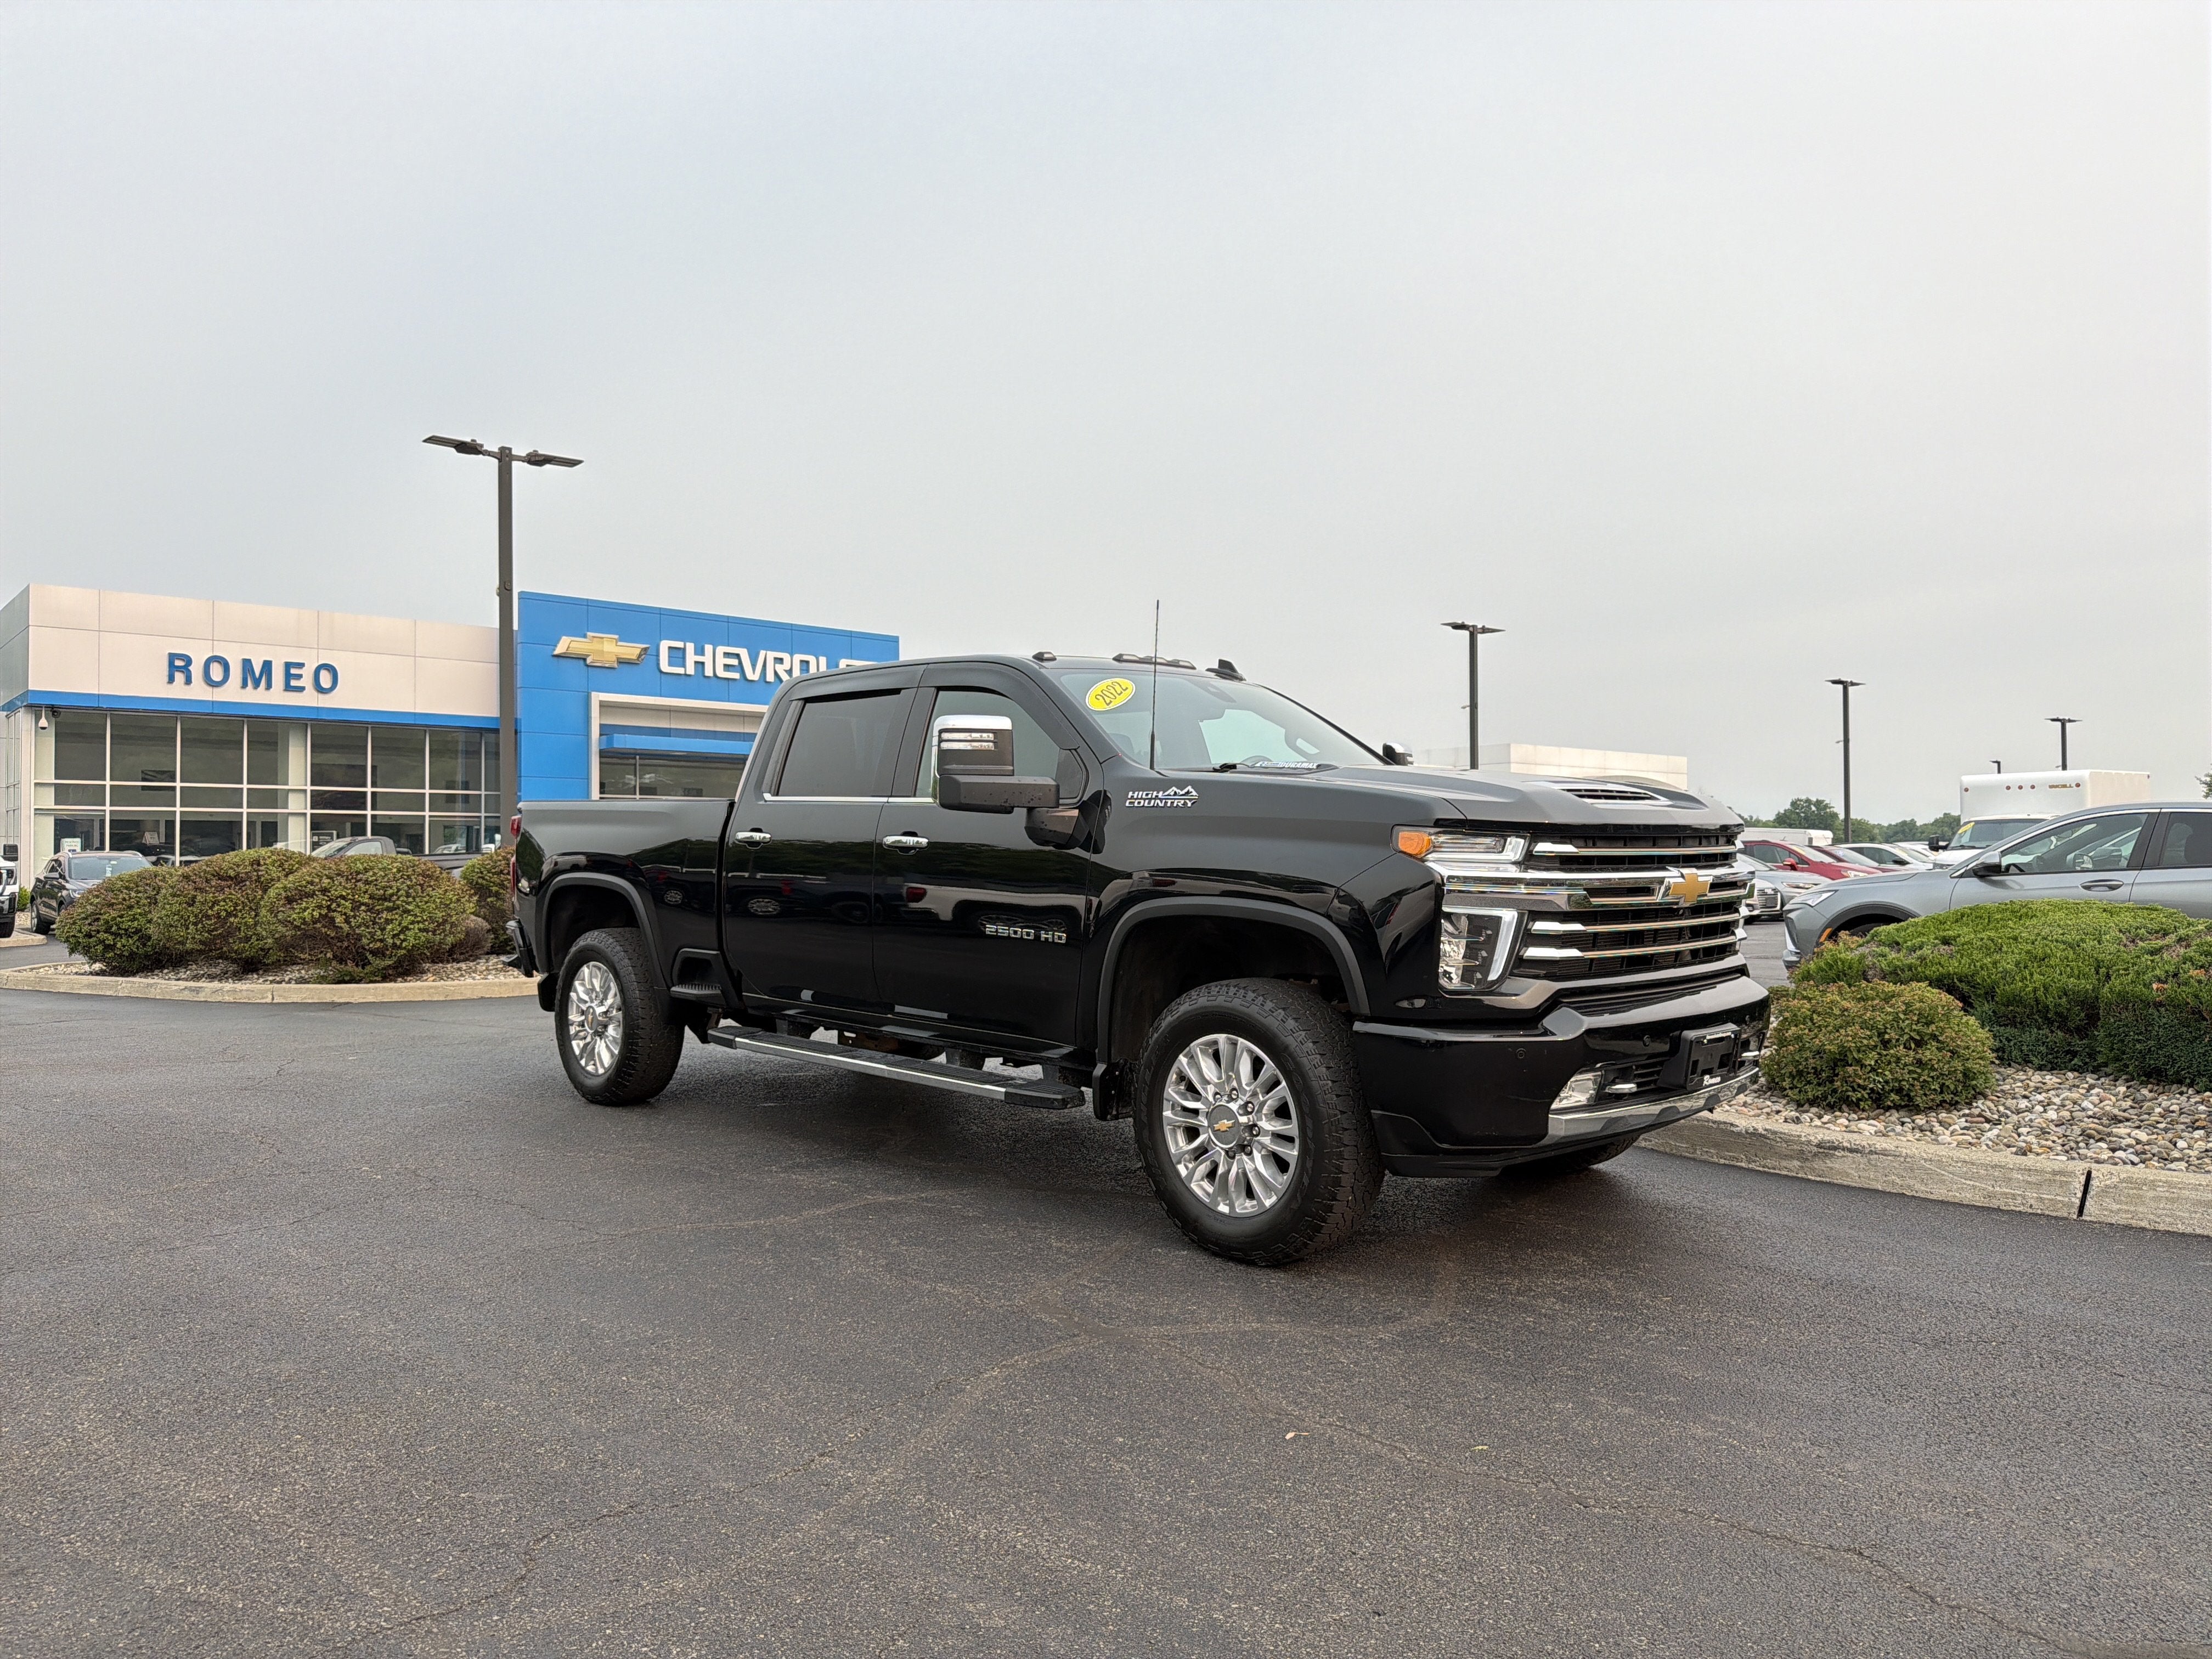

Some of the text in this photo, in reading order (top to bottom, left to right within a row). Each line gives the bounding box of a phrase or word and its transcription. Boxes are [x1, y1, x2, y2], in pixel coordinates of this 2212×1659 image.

[167, 652, 338, 693] ROMEO
[659, 640, 878, 682] CHEVRO
[1094, 681, 1128, 706] 2022
[985, 924, 1066, 944] 2500 HD
